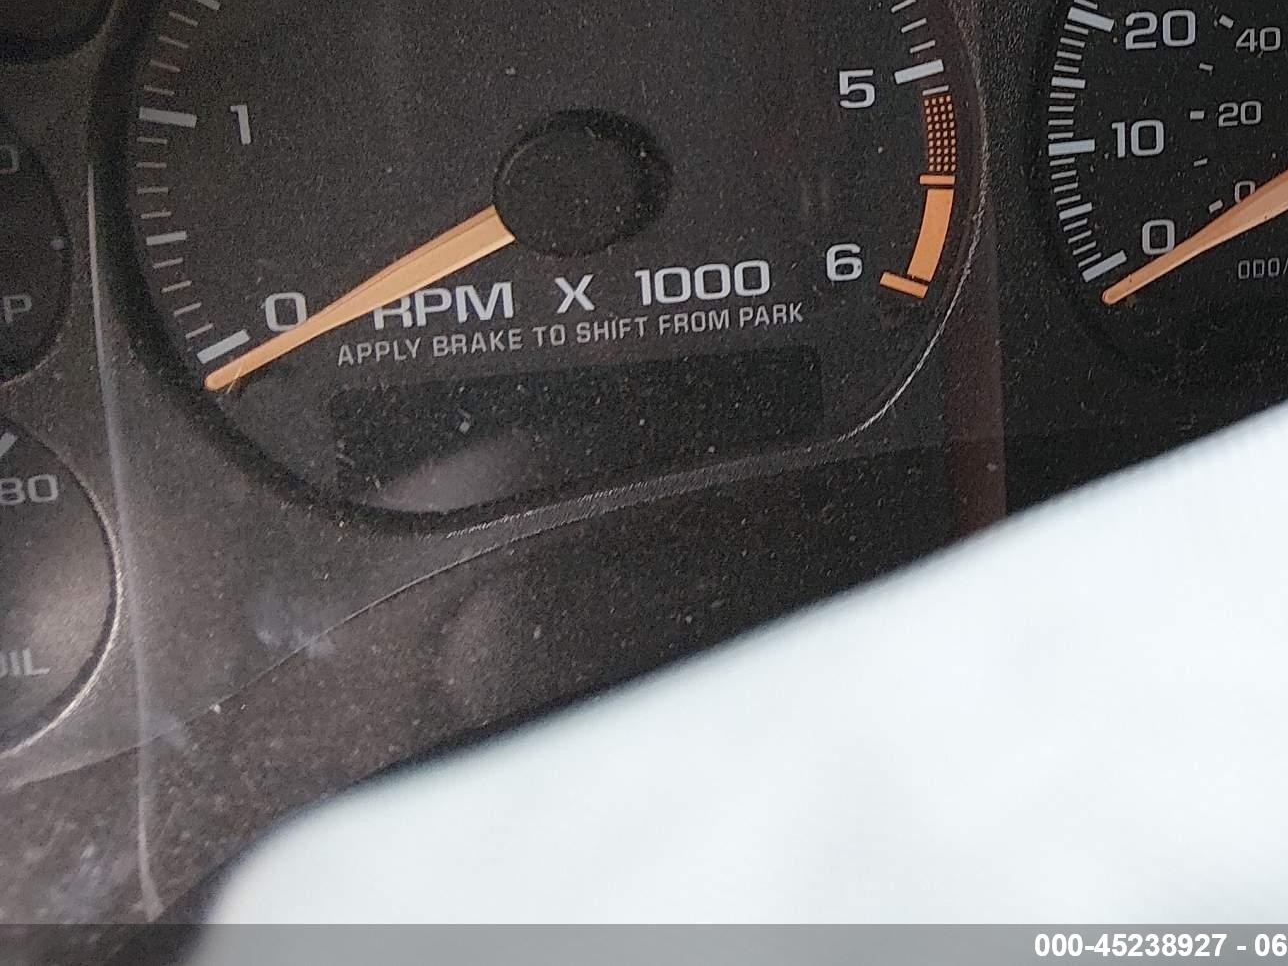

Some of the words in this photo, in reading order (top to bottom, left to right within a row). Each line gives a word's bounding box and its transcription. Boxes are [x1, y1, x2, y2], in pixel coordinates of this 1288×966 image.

[1124, 9, 1196, 50] 20
[1234, 26, 1282, 53] 40
[838, 68, 876, 109] 5
[229, 103, 252, 145] 1
[1217, 100, 1263, 128] 20
[1111, 119, 1165, 159] 10
[1141, 219, 1176, 256] 0
[824, 242, 864, 283] 6
[554, 274, 595, 315] X
[634, 258, 771, 307] 1000
[264, 291, 307, 333] 0
[337, 336, 422, 367] APPLY
[433, 327, 524, 360] BRAKE
[532, 323, 566, 349] TO
[575, 317, 648, 346] SHIFT
[657, 309, 731, 337] FROM
[737, 300, 804, 329] PARK
